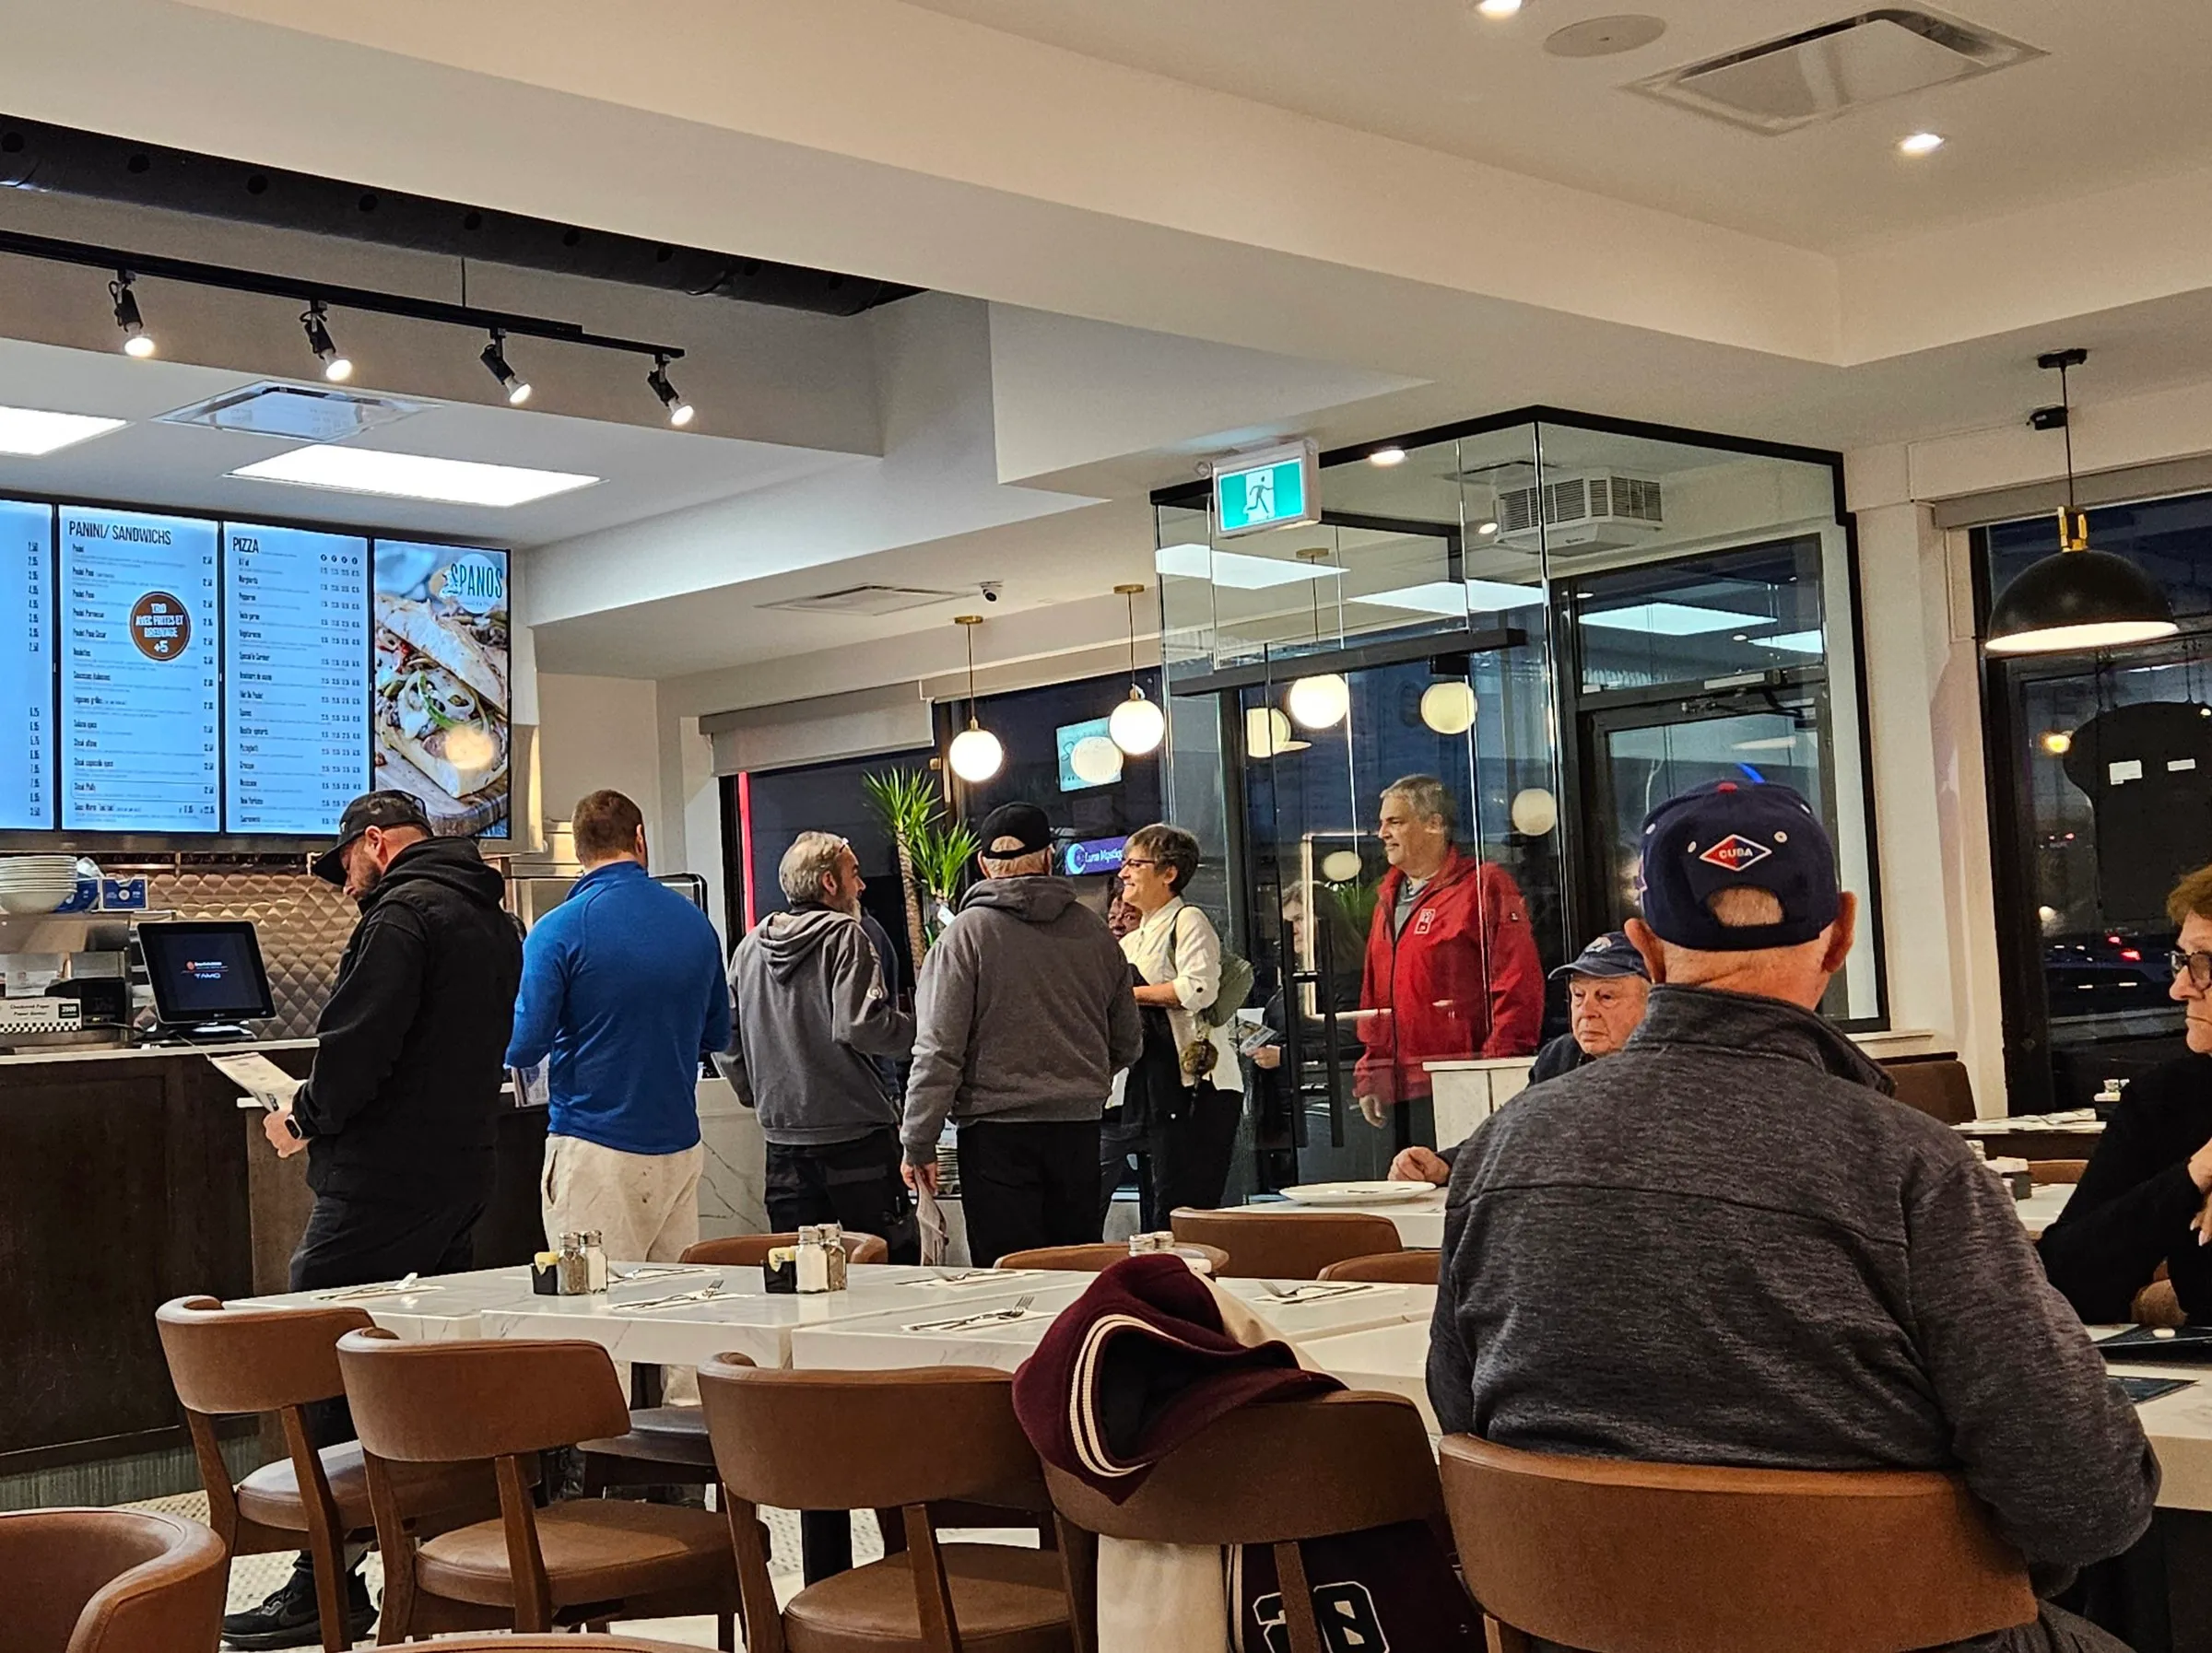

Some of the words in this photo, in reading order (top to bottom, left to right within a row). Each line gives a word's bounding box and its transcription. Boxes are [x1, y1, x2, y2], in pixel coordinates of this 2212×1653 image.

[69, 521, 110, 539] PANINI/
[112, 524, 172, 545] SANDWICHS
[232, 536, 259, 554] PIZZA
[450, 563, 503, 599] SPANOS
[1718, 848, 1753, 860] CUBA
